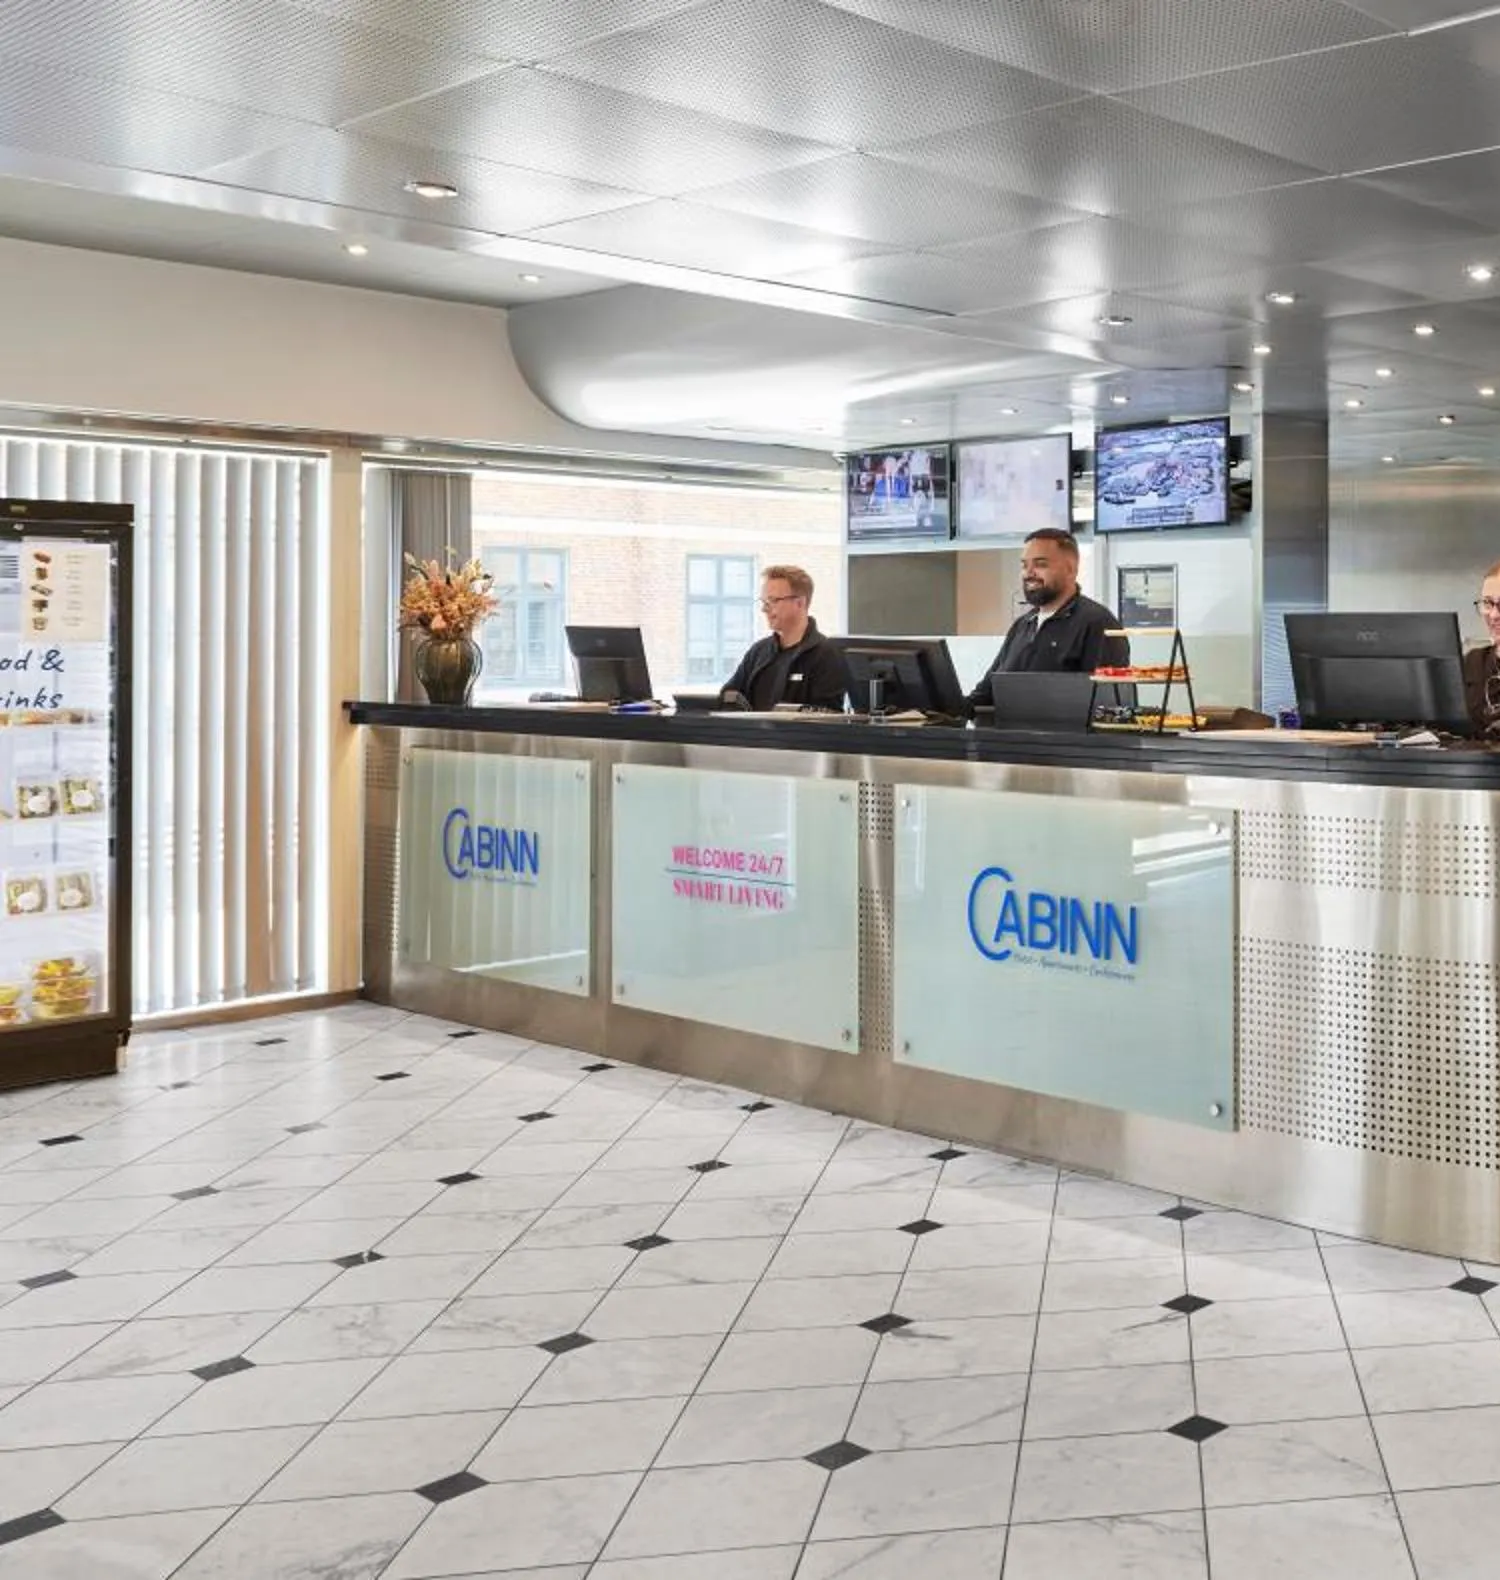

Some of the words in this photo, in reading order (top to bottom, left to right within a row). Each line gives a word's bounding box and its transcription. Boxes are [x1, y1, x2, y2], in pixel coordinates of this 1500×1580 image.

[41, 649, 64, 672] &
[0, 687, 63, 709] inks
[443, 807, 539, 877] CABINN
[671, 846, 745, 872] WELCOME
[748, 853, 784, 877] 24/7
[672, 879, 722, 902] SMART
[967, 866, 1139, 965] CABINN
